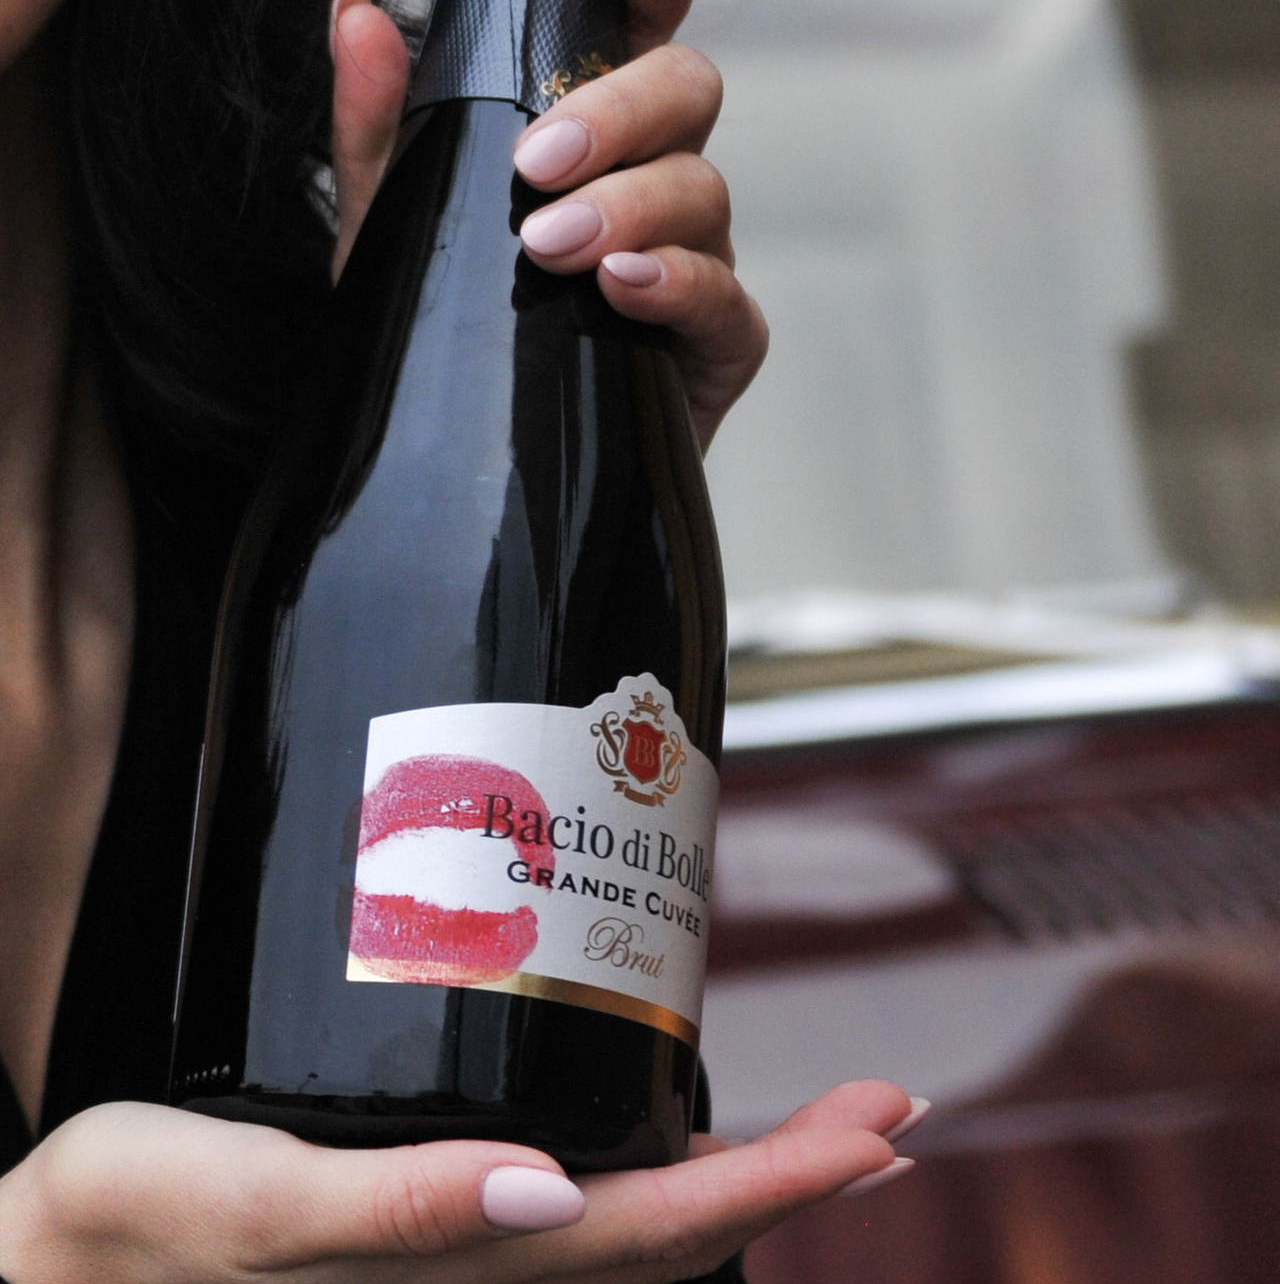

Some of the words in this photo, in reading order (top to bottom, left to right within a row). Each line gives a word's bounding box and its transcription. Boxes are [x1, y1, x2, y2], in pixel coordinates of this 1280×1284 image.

[480, 793, 614, 859] Bacio
[622, 828, 651, 872] di
[507, 860, 637, 909] GRANDE
[645, 891, 701, 938] CUVÉE
[584, 917, 665, 978] Brut
